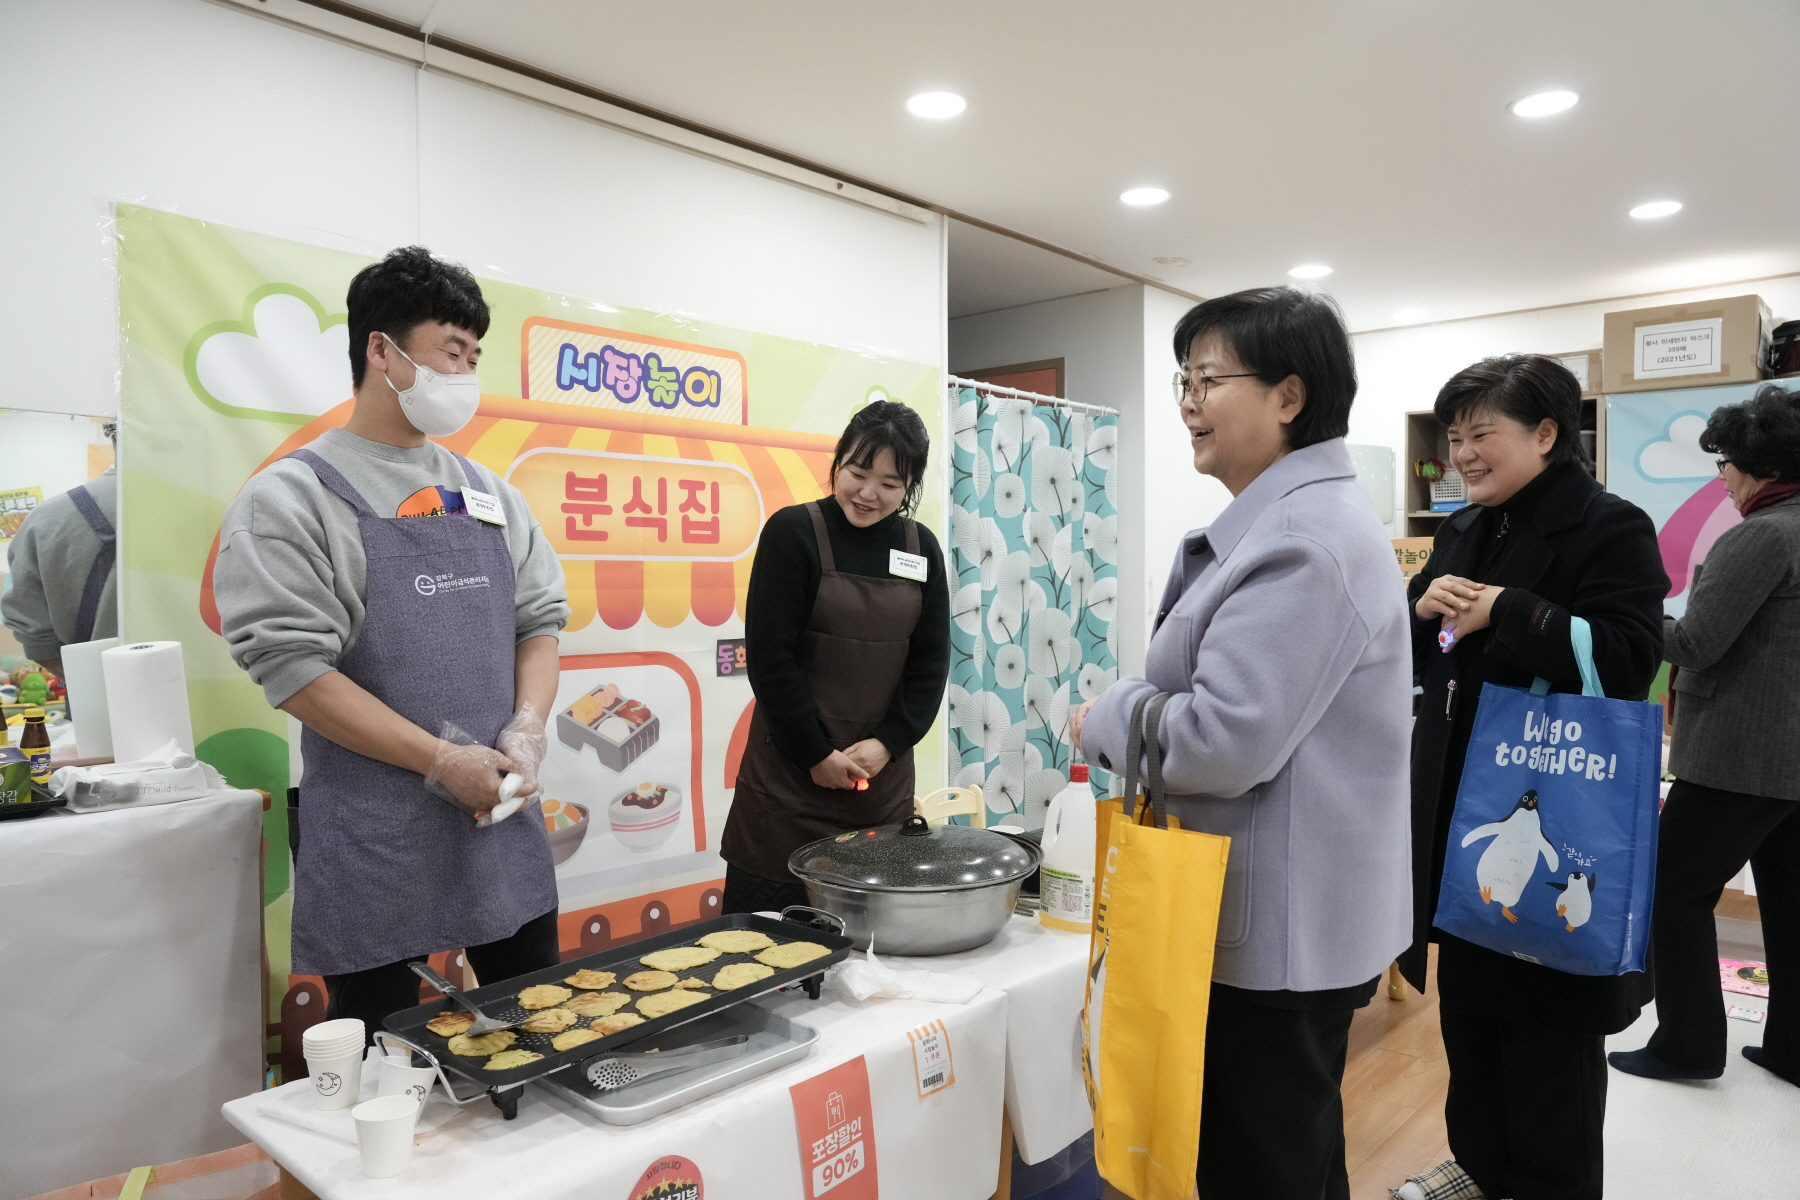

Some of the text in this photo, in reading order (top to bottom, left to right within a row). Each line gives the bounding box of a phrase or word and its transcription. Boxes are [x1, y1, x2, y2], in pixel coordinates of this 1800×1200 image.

[1661, 336, 1687, 344] 미세먼지
[1690, 333, 1710, 341] 마스크
[1657, 353, 1697, 364] (2021년도)
[556, 343, 721, 409] 시장놀이
[560, 470, 720, 544] 분식집
[1549, 719, 1582, 745] go
[1574, 857, 1592, 867] 가요
[812, 1117, 862, 1164] 포장할인
[645, 1160, 682, 1180] 사랑합니다
[822, 1149, 859, 1188] 90%
